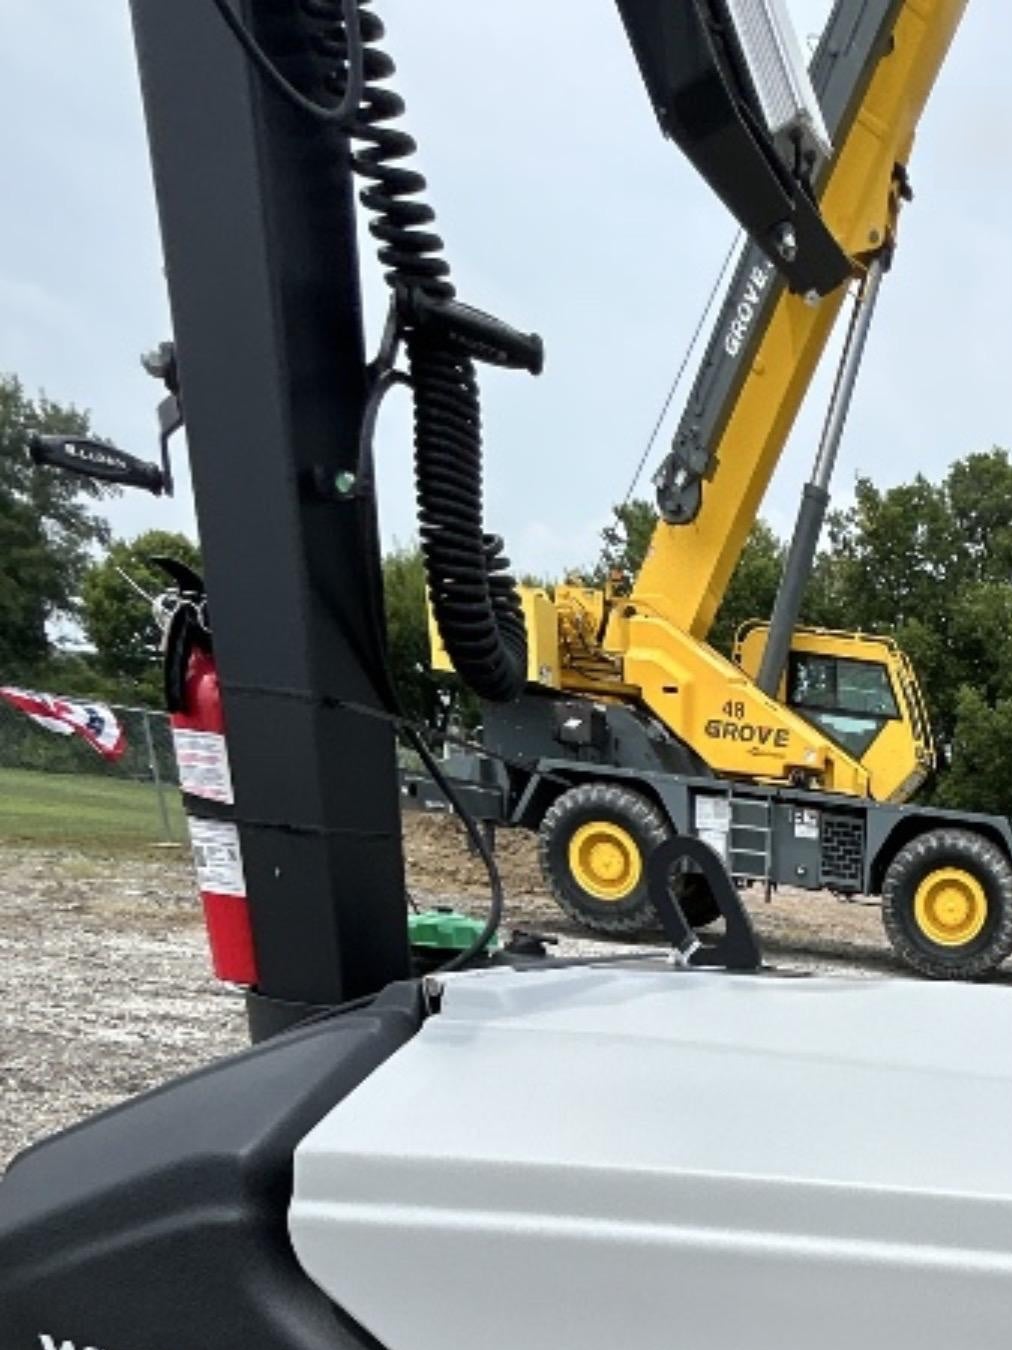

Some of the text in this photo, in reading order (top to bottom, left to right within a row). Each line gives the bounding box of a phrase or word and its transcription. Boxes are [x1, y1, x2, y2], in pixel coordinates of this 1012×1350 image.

[725, 265, 768, 357] GROVE
[722, 699, 745, 720] 48
[705, 719, 790, 747] GROVE
